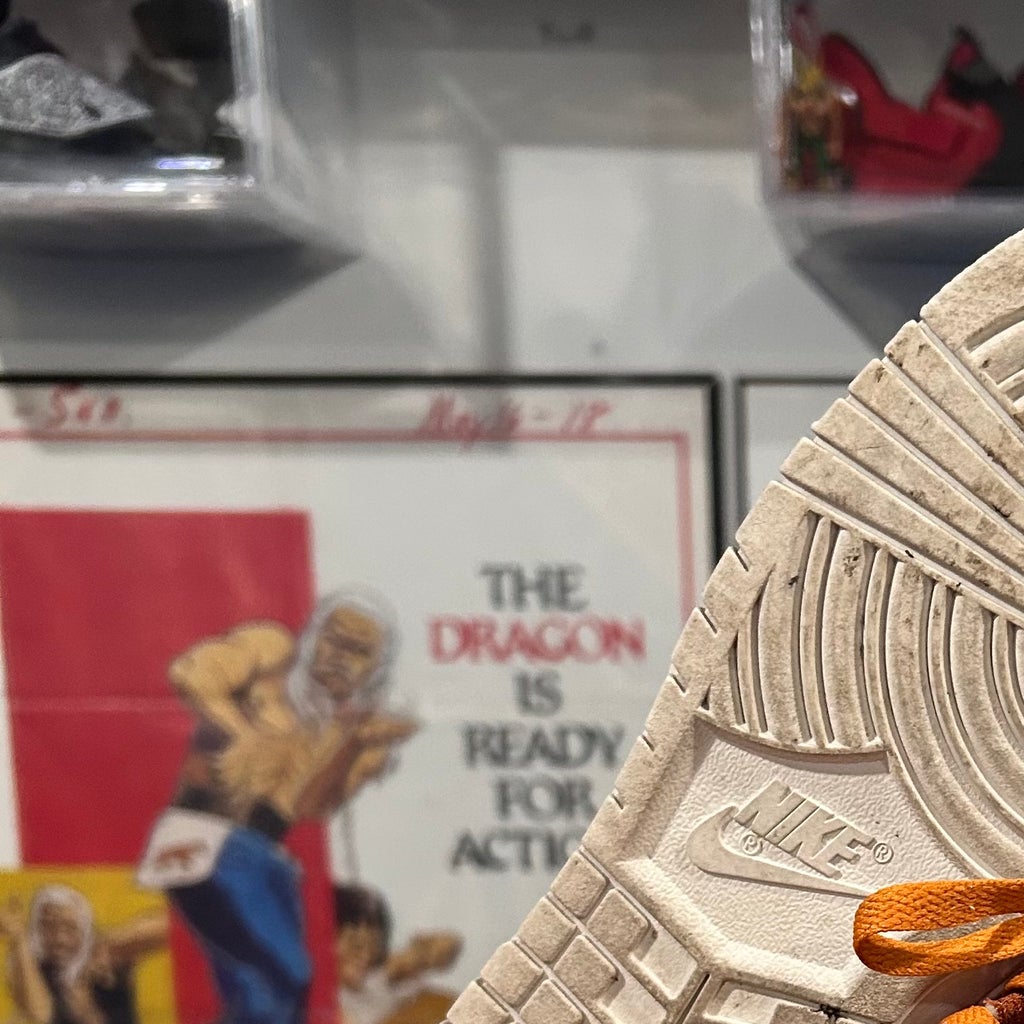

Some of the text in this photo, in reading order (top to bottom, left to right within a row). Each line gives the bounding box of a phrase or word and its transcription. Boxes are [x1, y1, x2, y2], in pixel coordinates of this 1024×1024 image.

[478, 560, 591, 612] THE
[426, 612, 648, 665] DRAGON
[513, 668, 564, 717] IS
[461, 719, 626, 770] READY
[494, 774, 600, 823] FOR
[449, 827, 592, 874] ACTI
